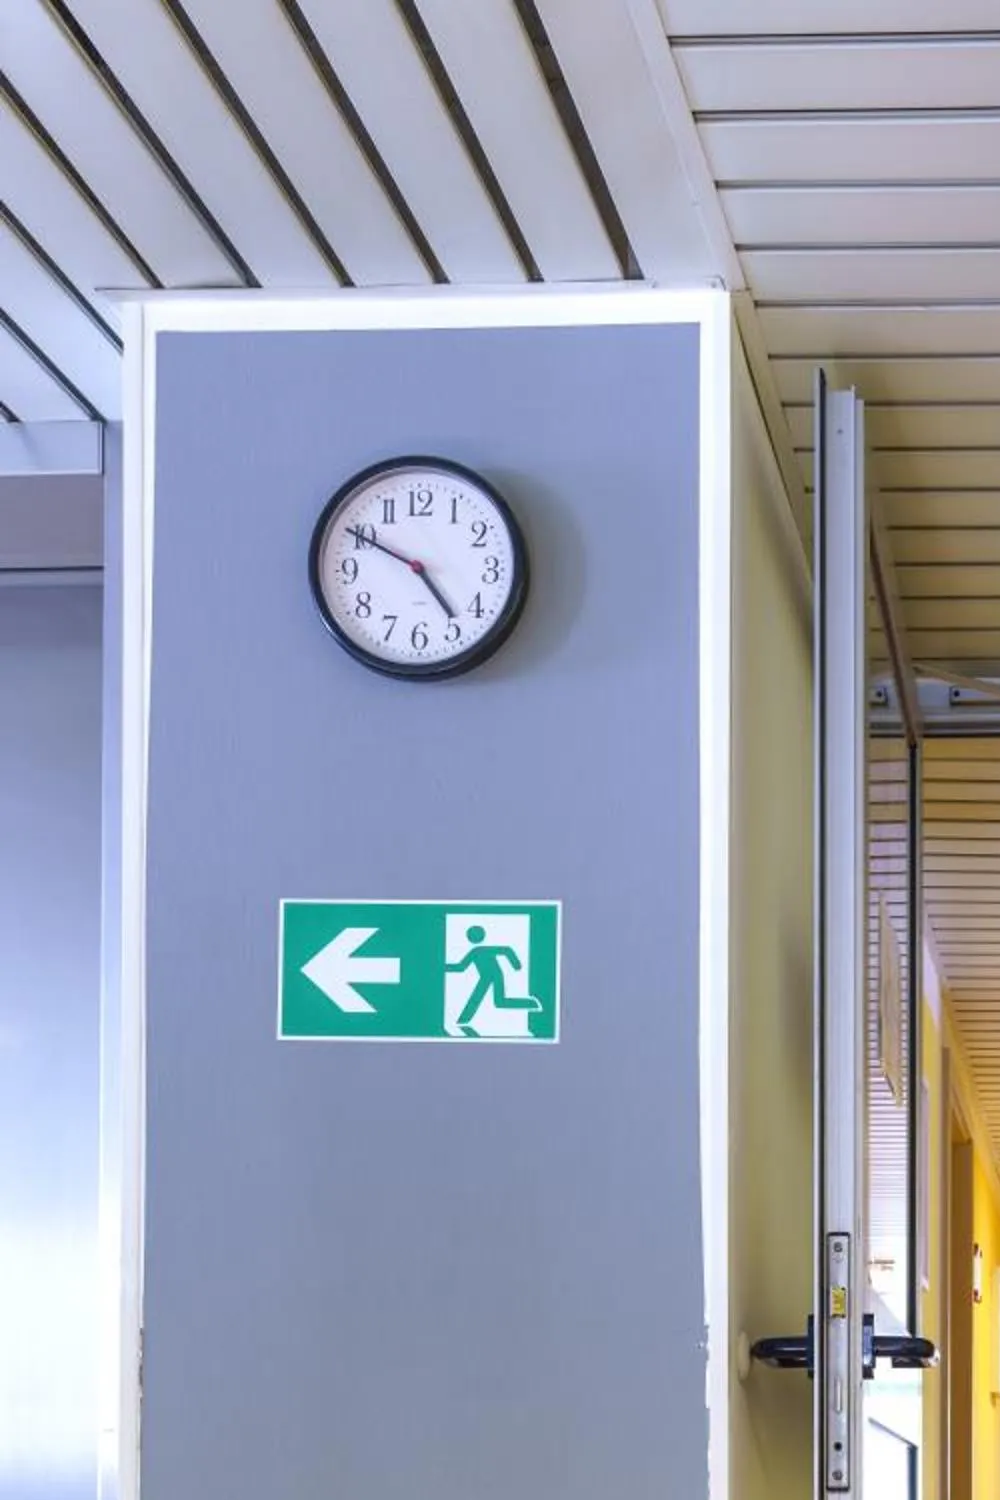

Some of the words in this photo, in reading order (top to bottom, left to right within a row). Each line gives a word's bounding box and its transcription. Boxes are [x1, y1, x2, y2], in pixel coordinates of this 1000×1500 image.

[383, 498, 397, 525] 11
[408, 489, 434, 517] 12
[451, 497, 458, 525] 1
[352, 523, 377, 550] 10
[471, 521, 487, 548] 2
[341, 557, 359, 585] 9
[481, 556, 499, 584] 3
[355, 592, 371, 619] 8
[468, 592, 485, 619] 4
[383, 615, 398, 642] 7
[411, 622, 429, 650] 6
[445, 616, 461, 642] 5
